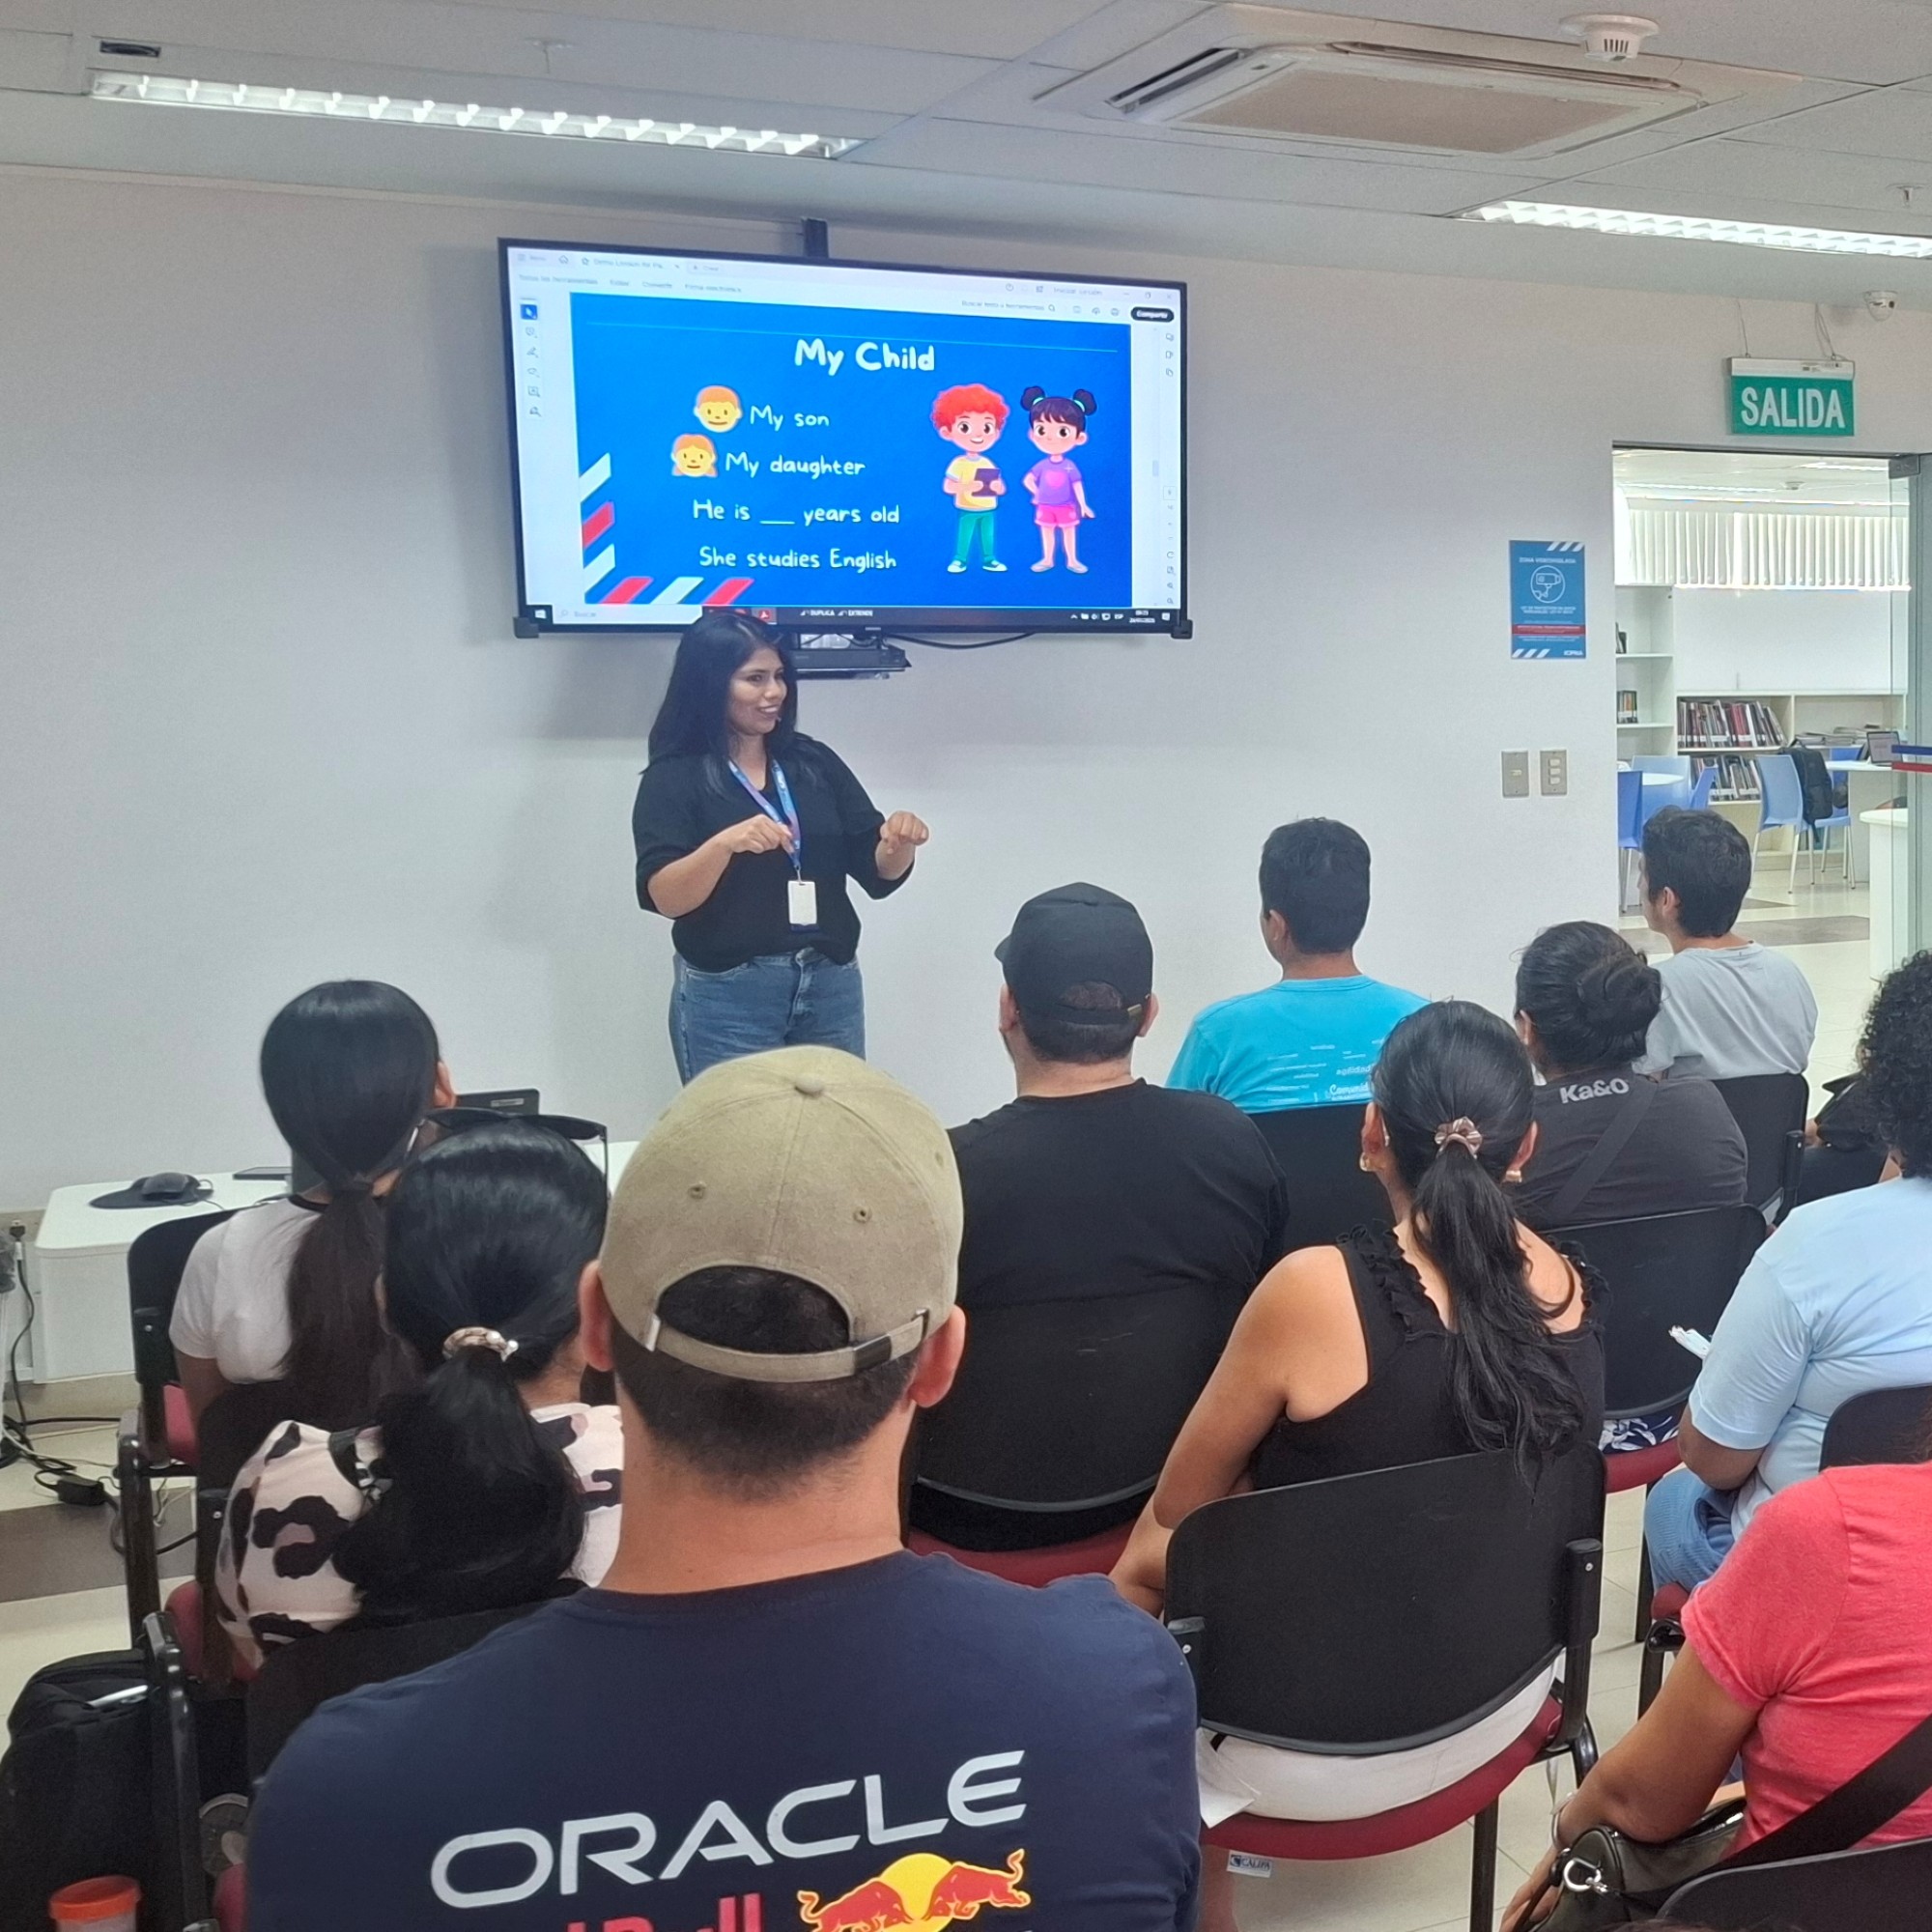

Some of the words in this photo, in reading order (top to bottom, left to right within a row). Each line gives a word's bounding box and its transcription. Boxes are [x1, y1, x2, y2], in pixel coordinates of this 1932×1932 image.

[794, 338, 844, 377] My
[855, 341, 935, 372] Child
[750, 404, 783, 432] My
[794, 412, 830, 428] son
[1741, 385, 1846, 429] SALIDA
[725, 451, 759, 478] My
[770, 454, 866, 480] daughter
[693, 498, 724, 521] He
[734, 503, 751, 521] is
[803, 507, 862, 526] years
[870, 504, 900, 524] old
[698, 546, 736, 568] She
[747, 549, 820, 568] studies
[830, 548, 896, 574] English
[1559, 1077, 1630, 1104] Ka&O
[430, 1749, 1027, 1909] ORACLE
